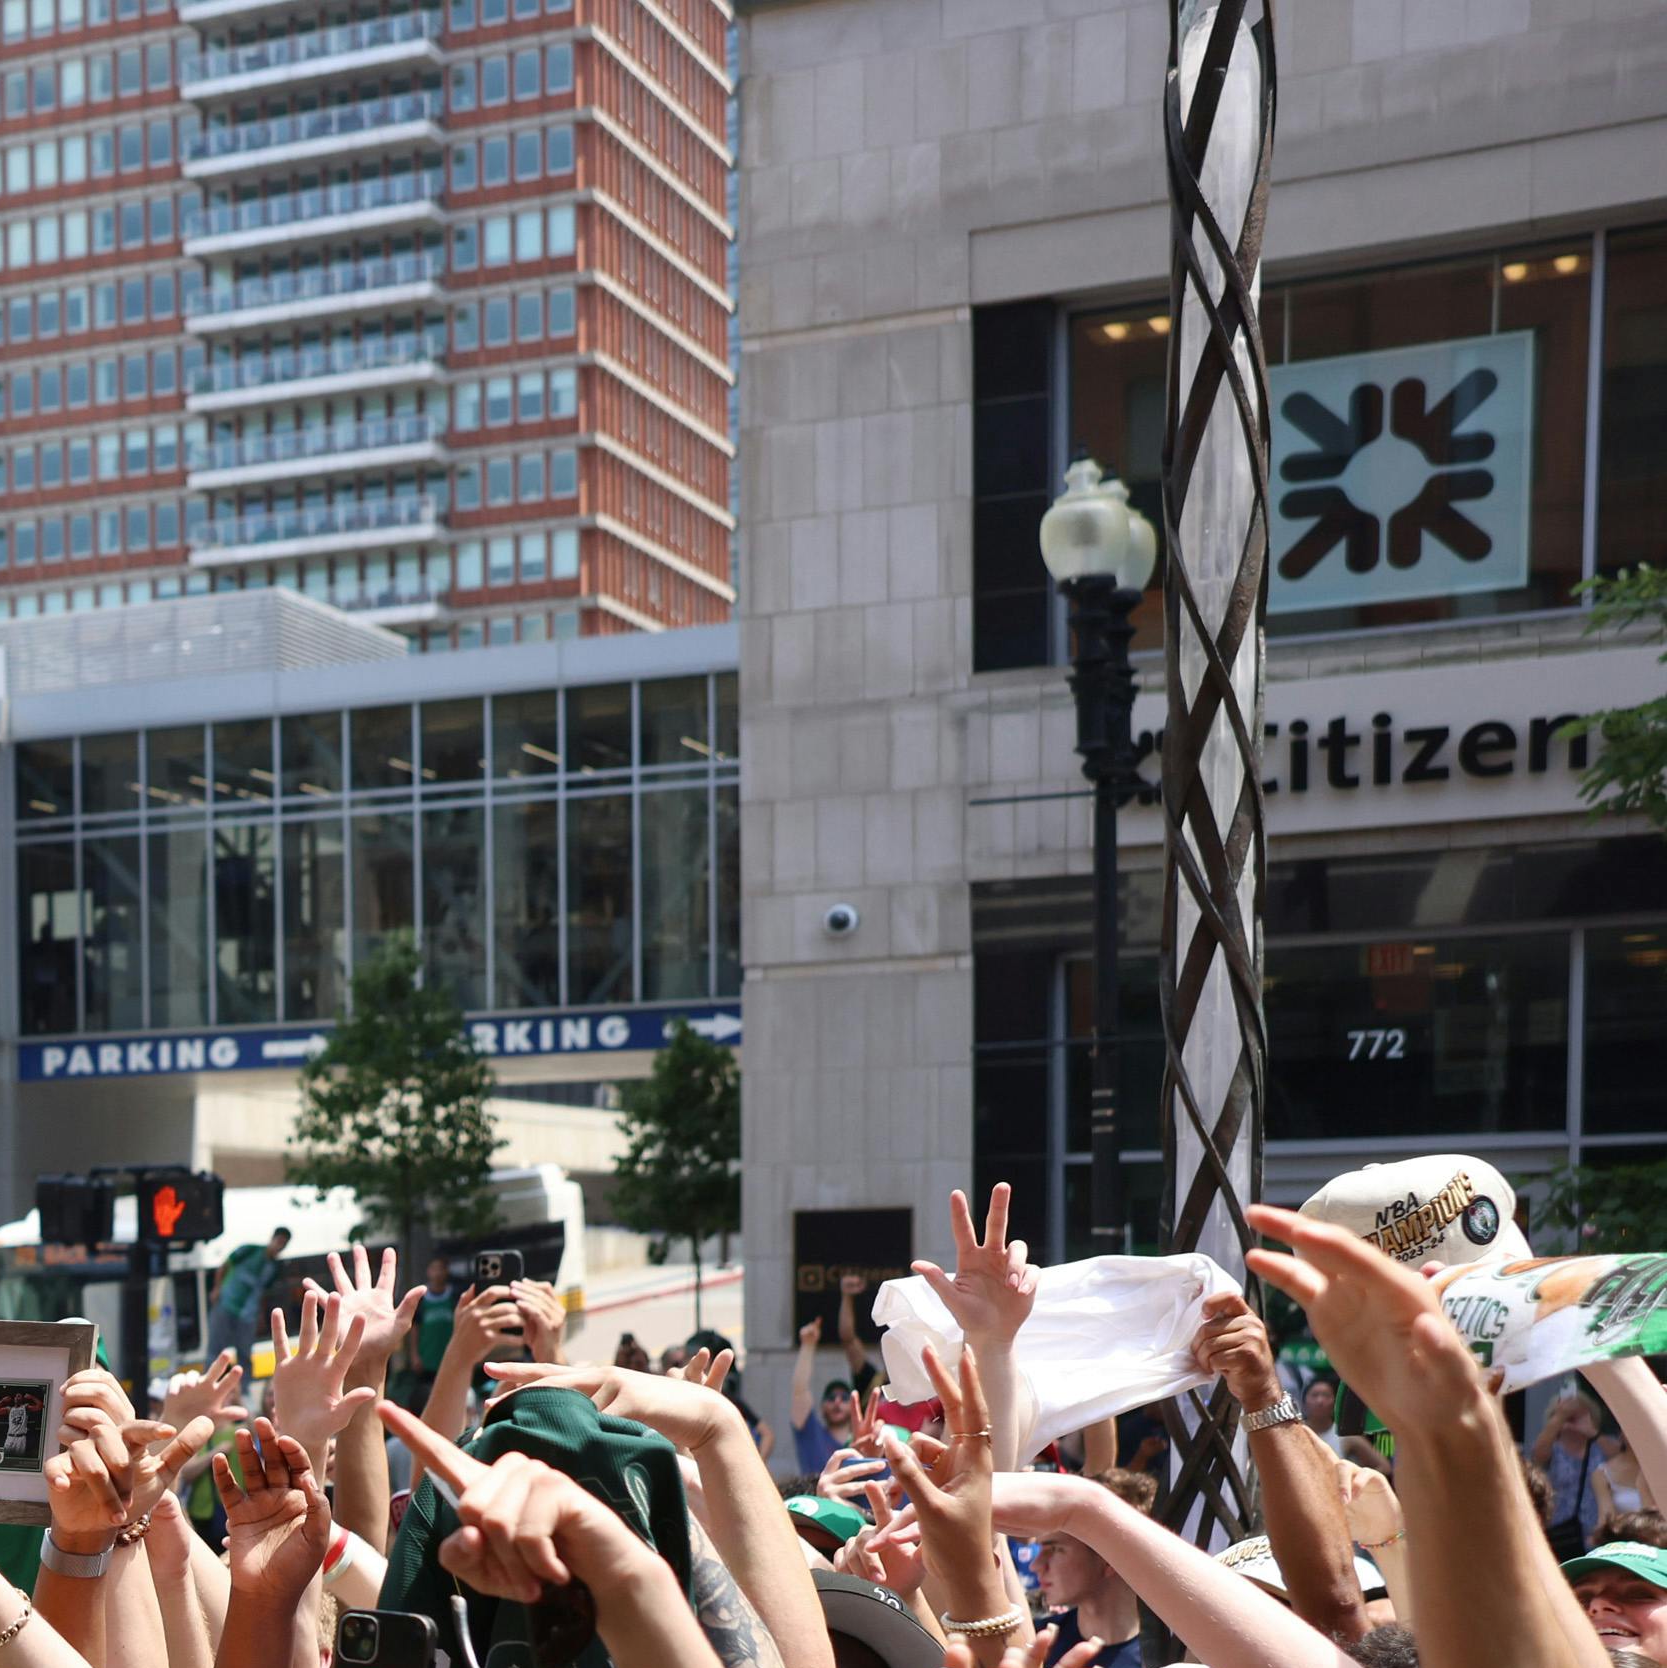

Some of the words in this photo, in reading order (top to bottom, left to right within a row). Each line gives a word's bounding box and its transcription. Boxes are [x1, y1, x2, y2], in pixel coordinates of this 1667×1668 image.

[1263, 711, 1591, 795] itizen
[472, 1014, 631, 1055] RKING
[1347, 1027, 1406, 1061] 772
[42, 1037, 240, 1076] PARKING
[1375, 1191, 1420, 1228] NBA
[1442, 1296, 1509, 1340] CELTICS
